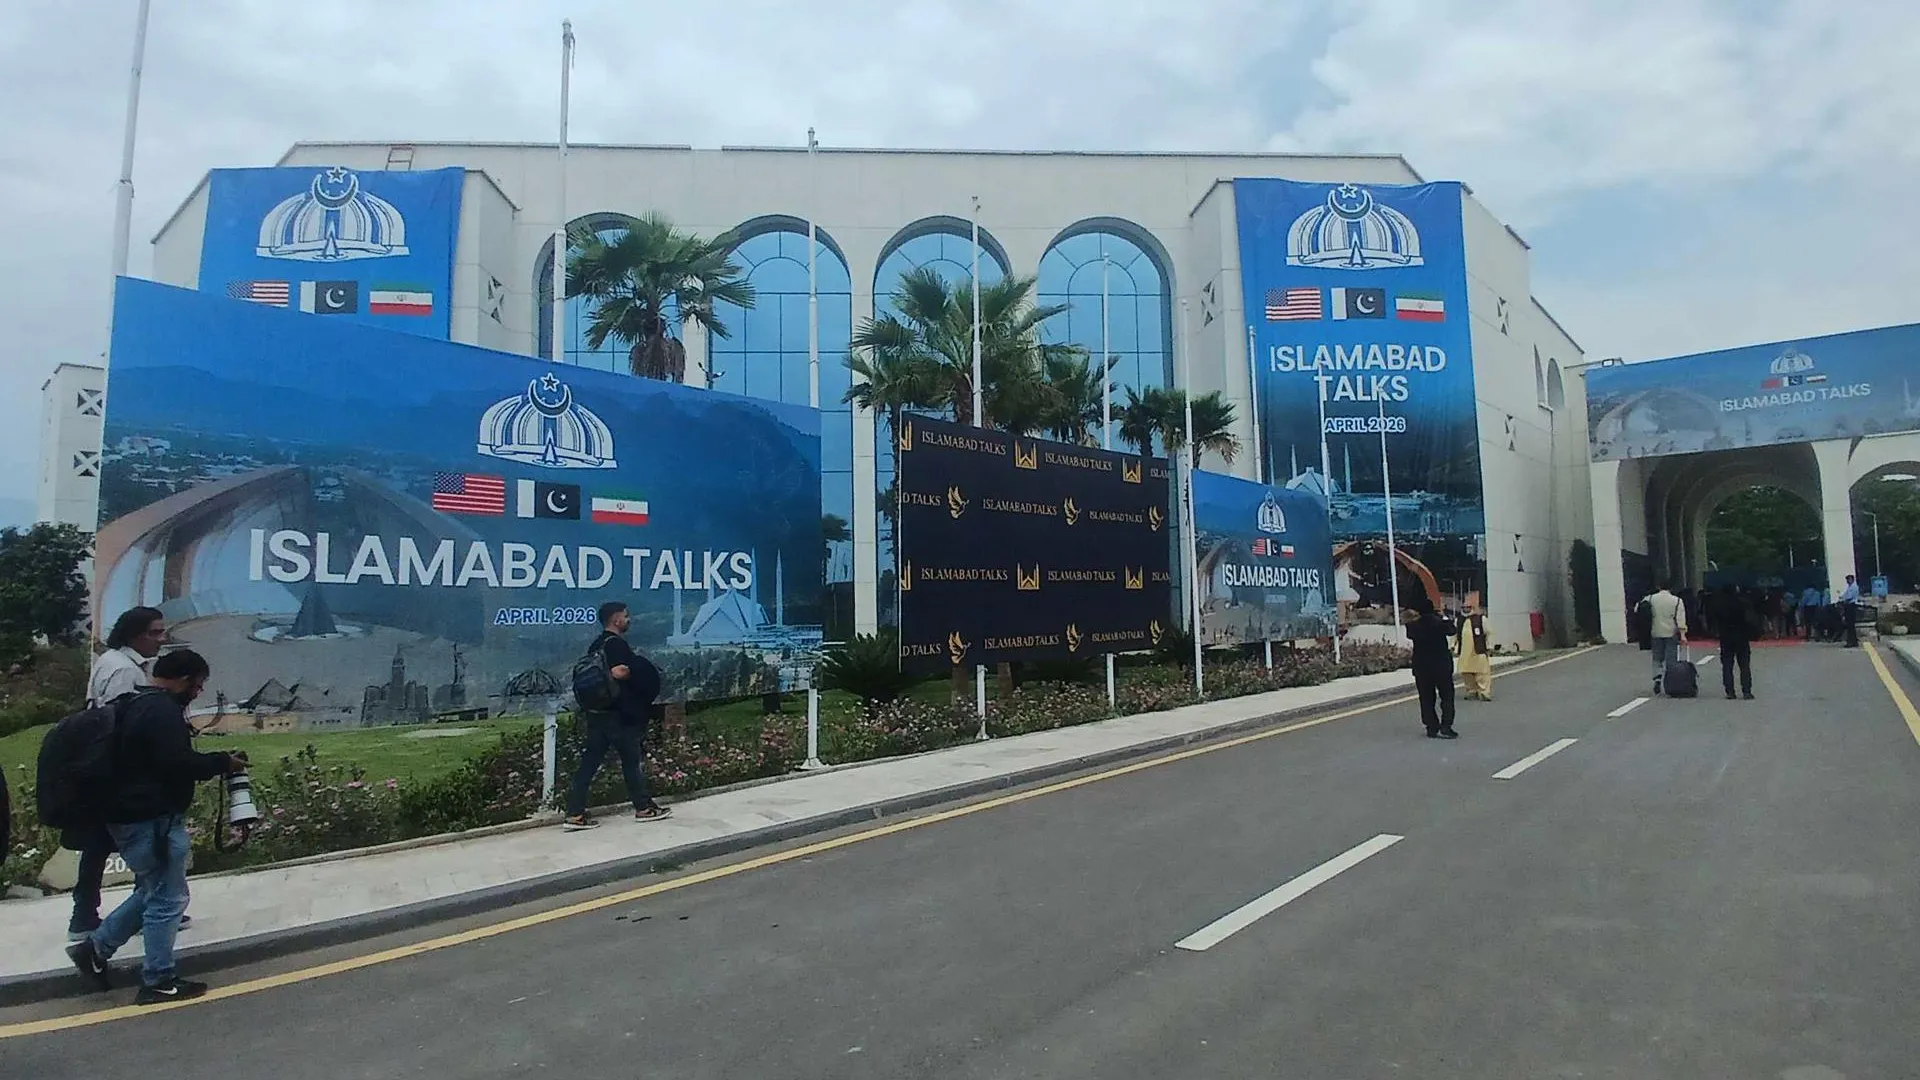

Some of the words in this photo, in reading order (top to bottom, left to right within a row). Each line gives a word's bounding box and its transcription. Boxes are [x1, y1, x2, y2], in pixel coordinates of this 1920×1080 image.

[1270, 344, 1446, 372] ISLAMABAD
[1313, 375, 1409, 401] TALKS
[1719, 390, 1815, 412] ISLAMABAD
[1818, 383, 1871, 400] TALKS
[1324, 417, 1367, 432] APRIL
[1369, 417, 1406, 432] 2026
[922, 430, 978, 450] ISLAMABAD
[979, 440, 1007, 455] TALKS
[1045, 452, 1089, 469] ISLAMABAD
[1090, 459, 1113, 471] TALKS
[911, 493, 941, 506] TALKS
[983, 499, 1032, 513] ISLAMABAD
[1033, 503, 1057, 516] TALKS
[1089, 510, 1125, 521] ISLAMABAD
[1125, 513, 1143, 523] TALKS
[248, 529, 614, 589] ISLAMABAD
[623, 548, 753, 590] TALKS
[921, 567, 979, 580] ISLAMABAD
[979, 569, 1008, 580] TALKS
[1047, 570, 1092, 581] ISLAMABAD
[1092, 571, 1116, 580] TALKS
[1222, 563, 1289, 588] ISLAMABAD
[1288, 567, 1319, 587] TALKS
[494, 609, 552, 625] APRIL
[553, 607, 597, 625] 2026
[984, 635, 1034, 650] ISLAMABAD
[1034, 635, 1060, 645] TALKS
[1091, 632, 1125, 642] ISLAMABAD
[1125, 630, 1145, 639] TALKS
[911, 643, 942, 656] TALKS
[103, 857, 131, 874] 20
